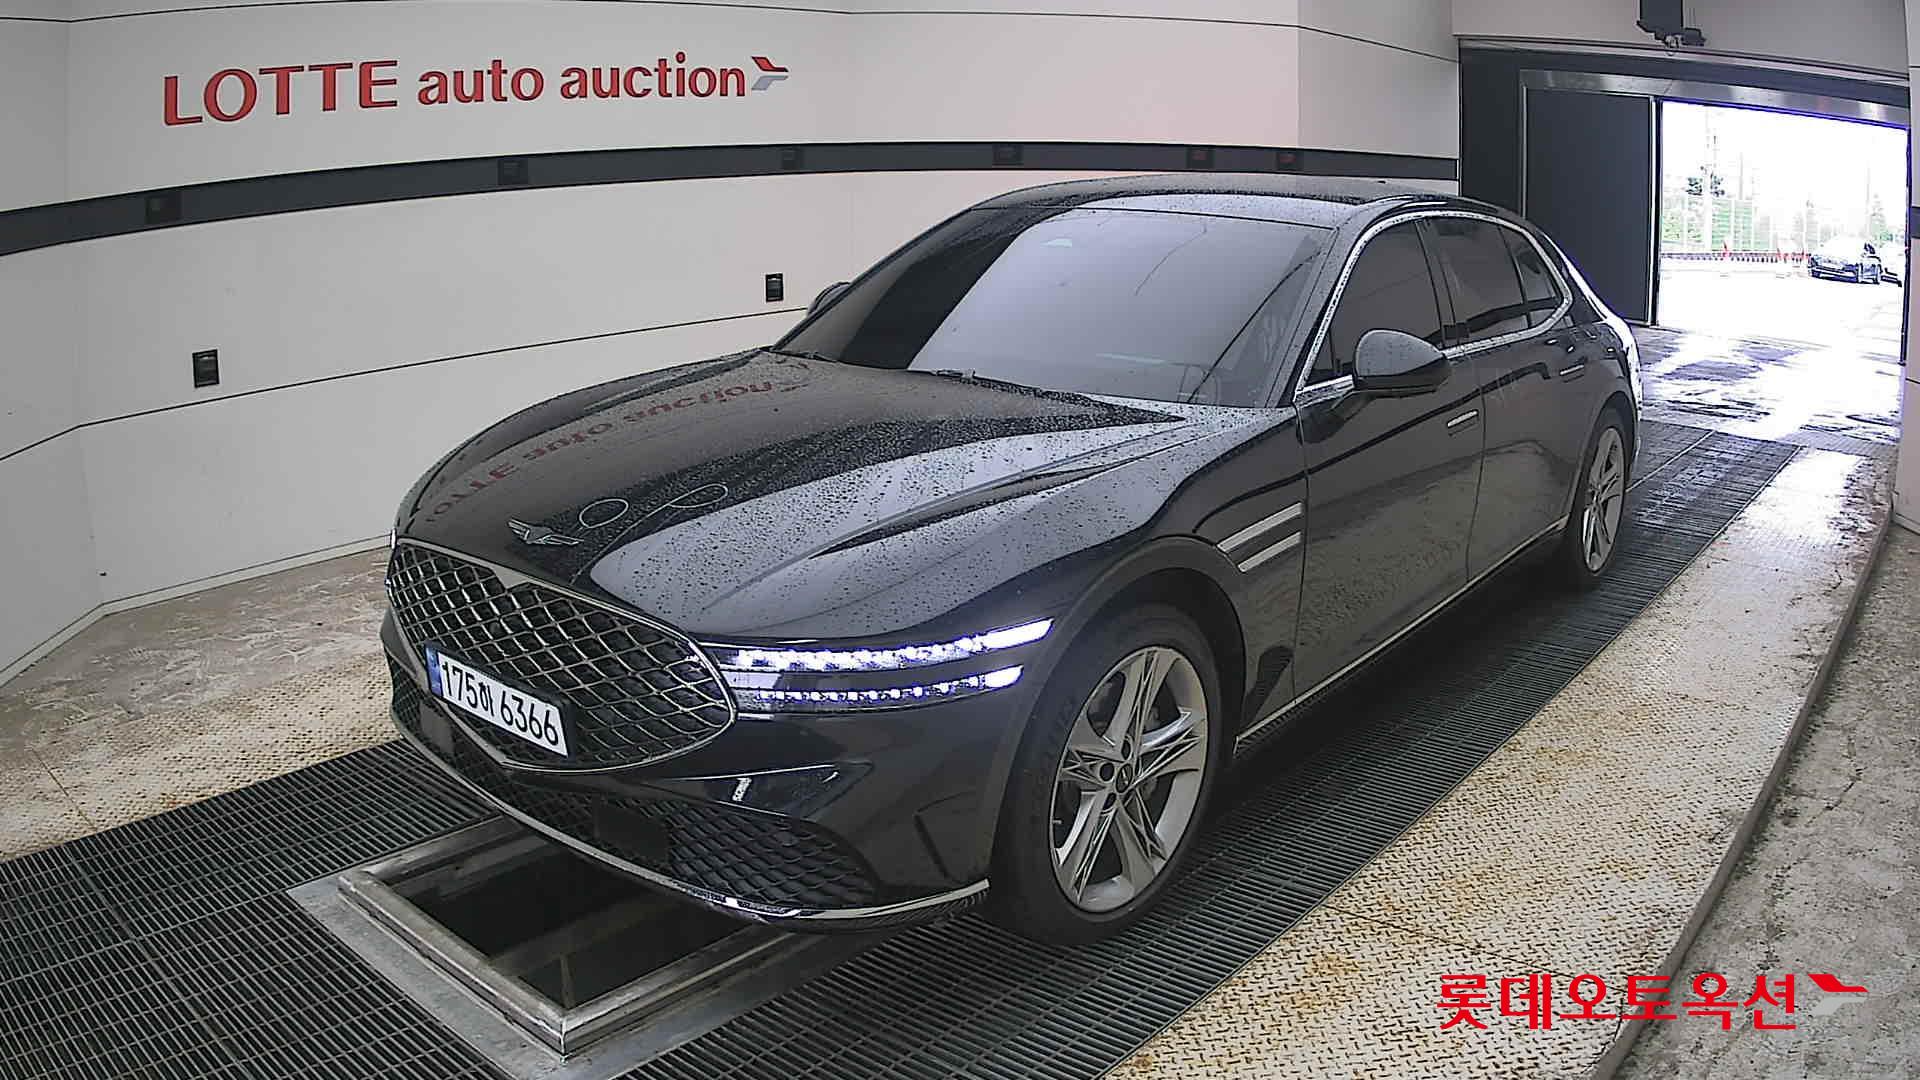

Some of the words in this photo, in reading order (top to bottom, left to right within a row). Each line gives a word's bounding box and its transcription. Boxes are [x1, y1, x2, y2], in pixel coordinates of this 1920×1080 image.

[164, 60, 398, 126] LOTTE
[418, 59, 544, 105] auto
[561, 51, 746, 99] auction
[442, 661, 495, 717] 175하
[500, 690, 559, 746] 6366
